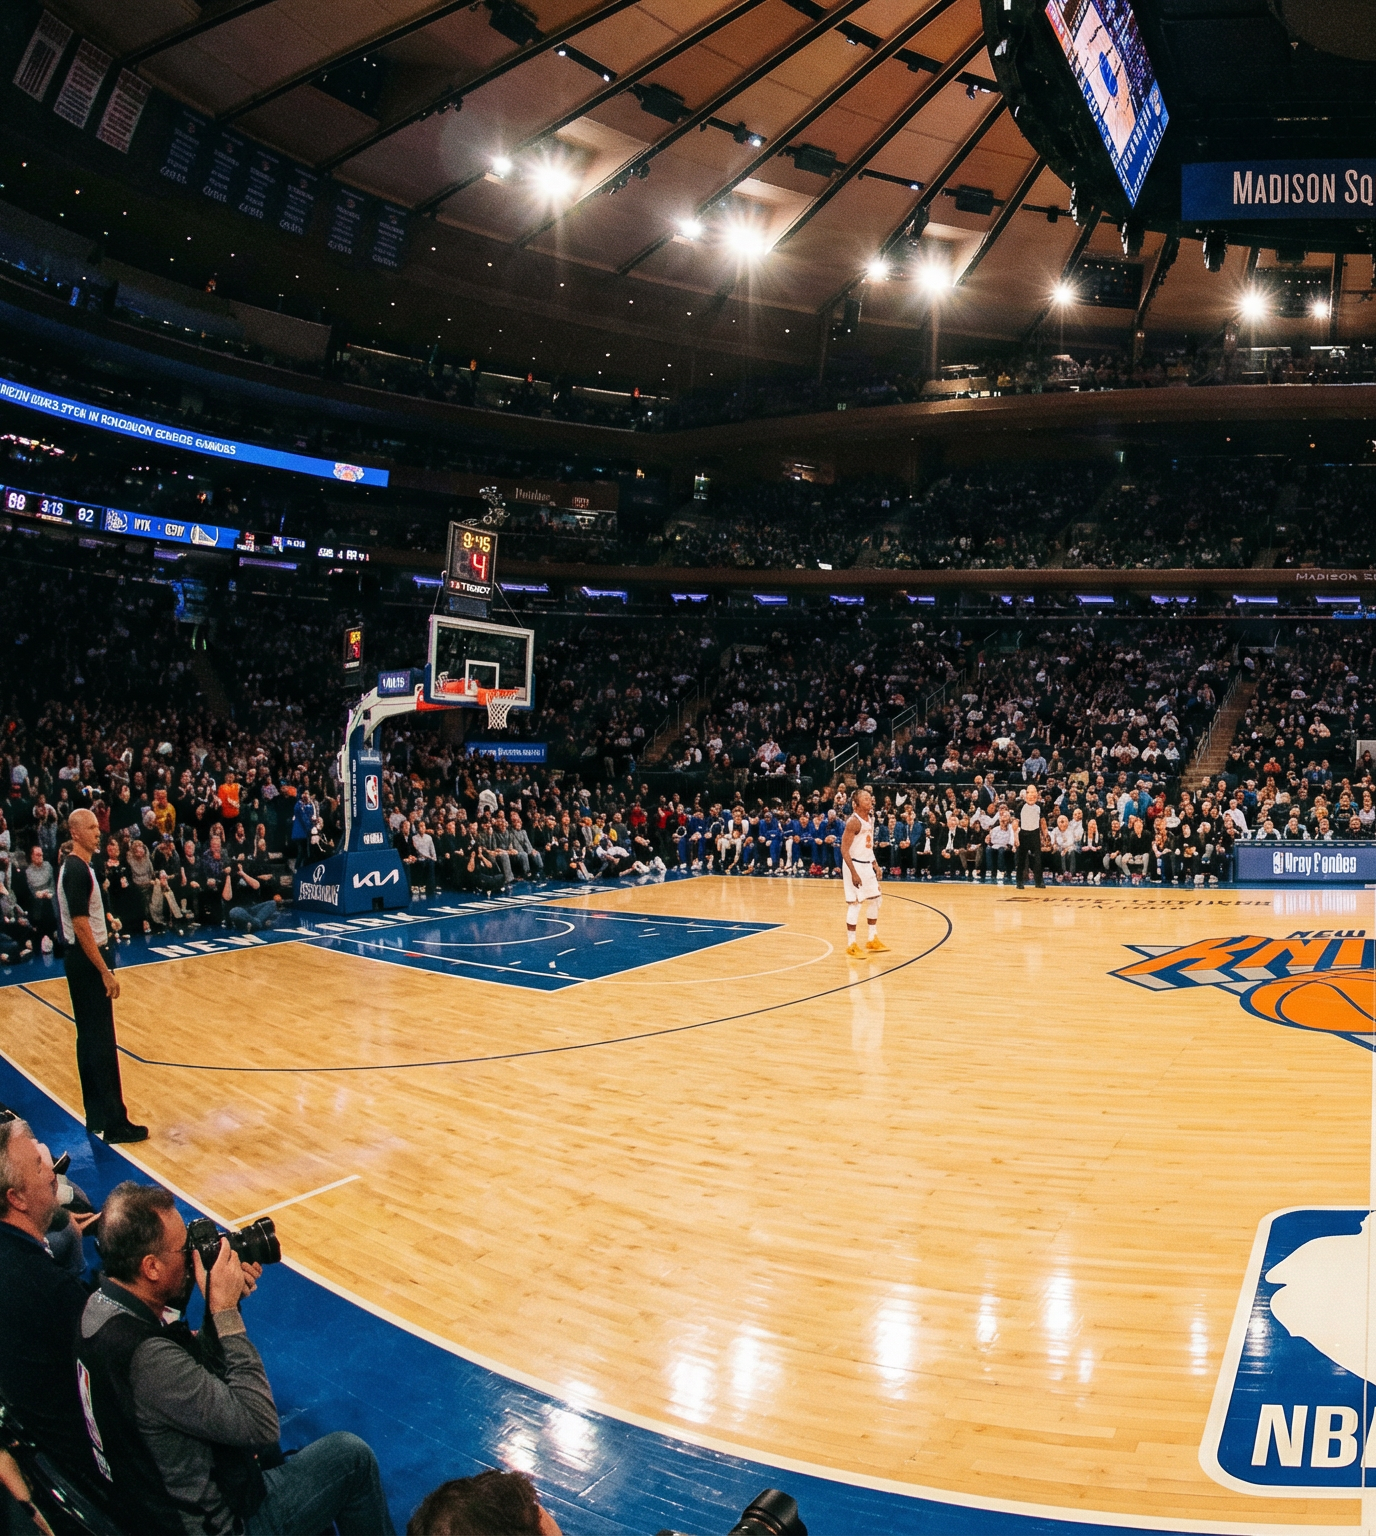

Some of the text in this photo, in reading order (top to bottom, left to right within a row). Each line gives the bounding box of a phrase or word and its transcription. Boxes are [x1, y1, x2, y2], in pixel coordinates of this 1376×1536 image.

[1233, 171, 1336, 204] MADISON
[472, 553, 486, 579] 4
[148, 934, 268, 958] NEW
[1285, 929, 1366, 939] NEW
